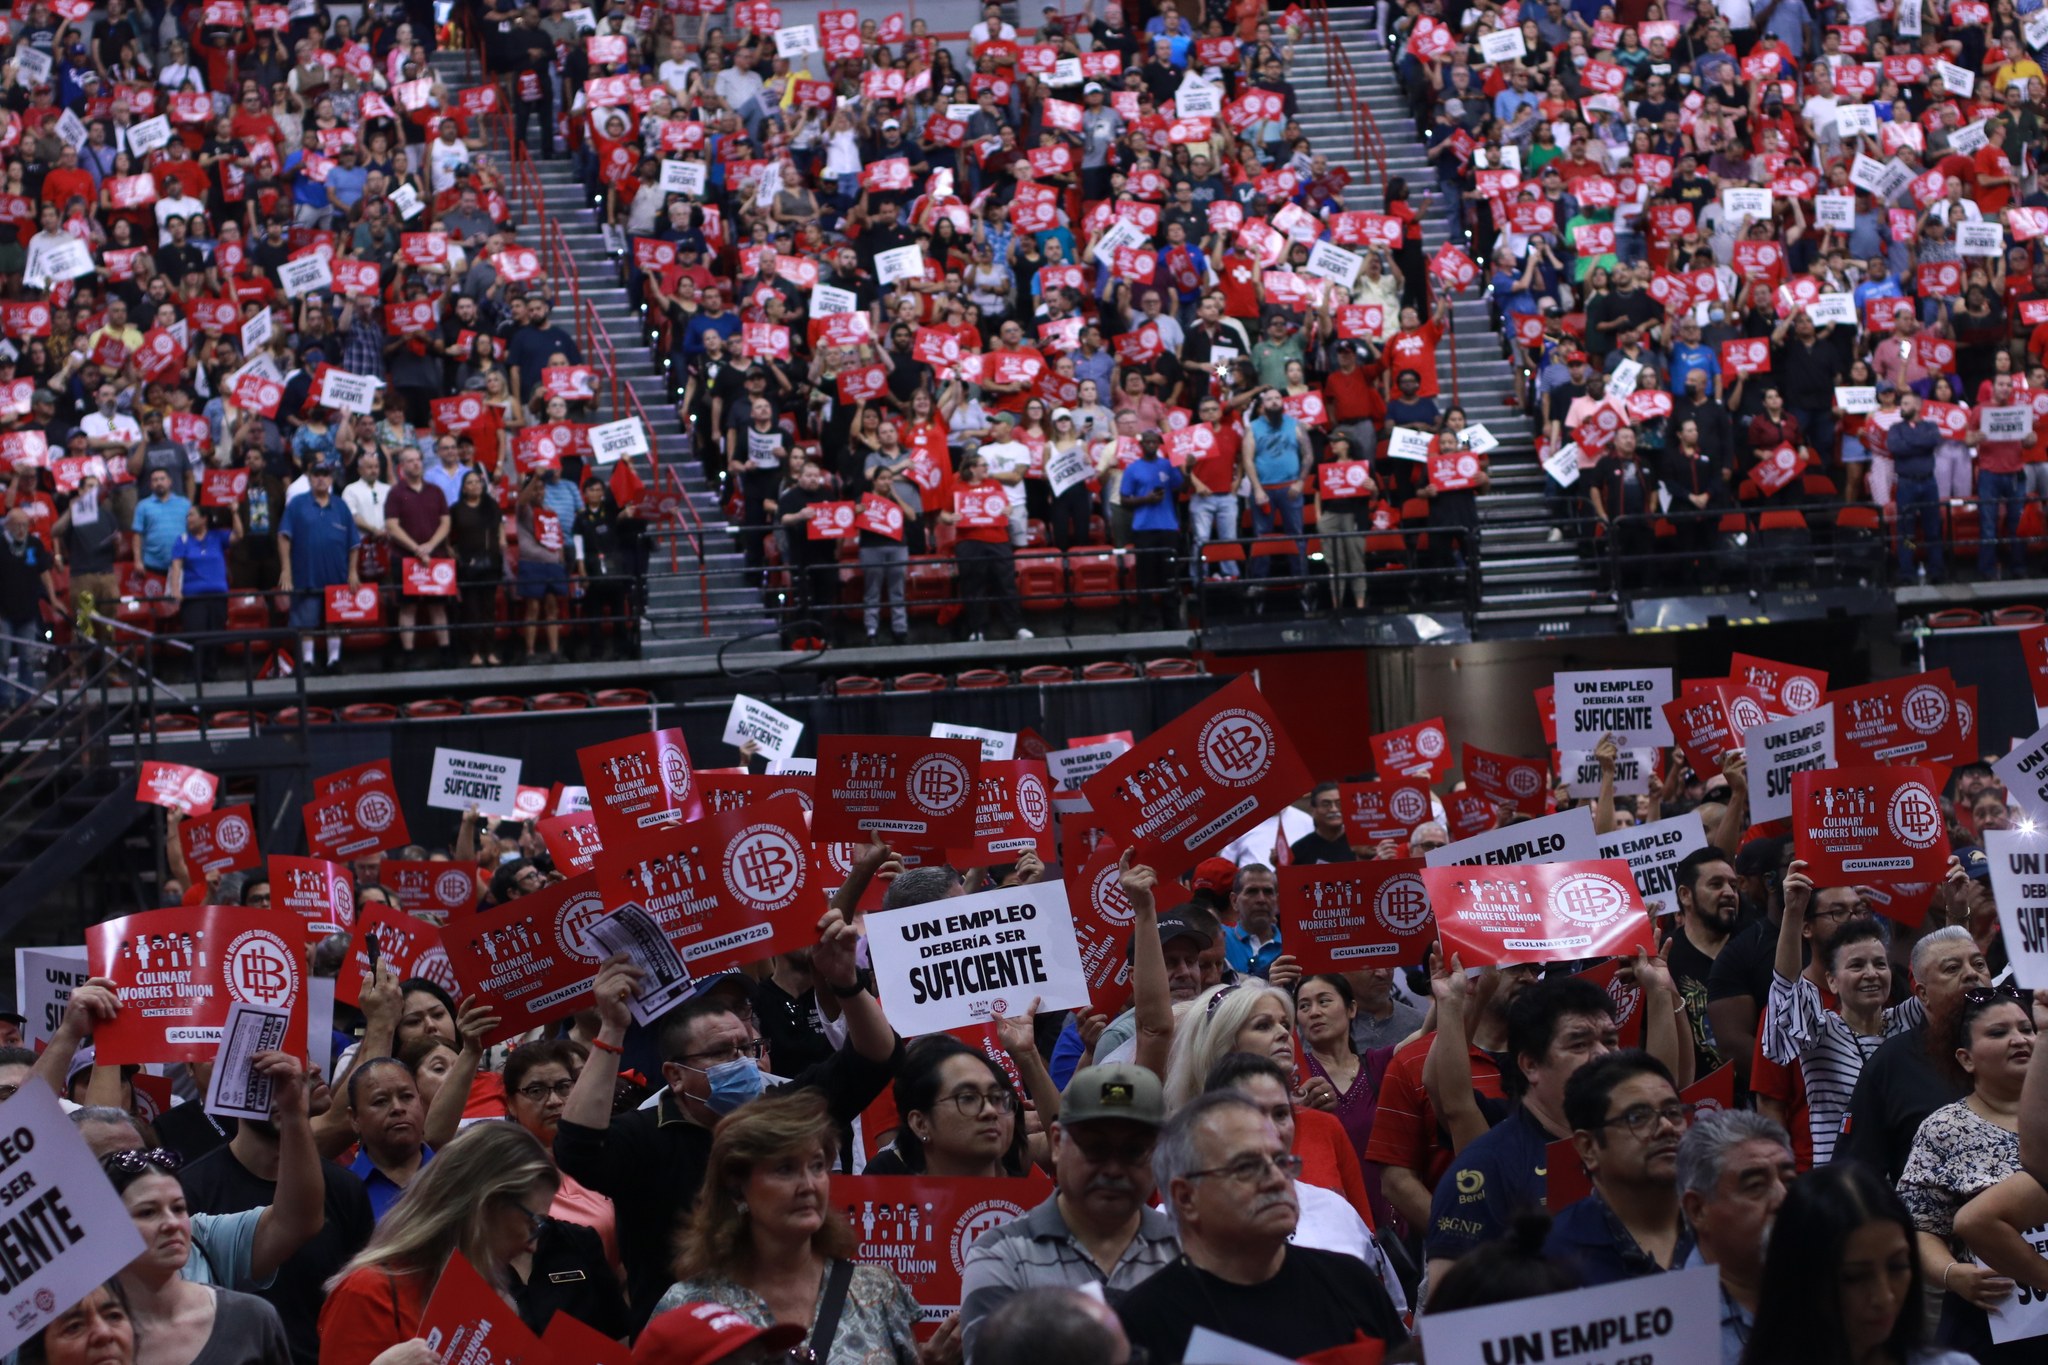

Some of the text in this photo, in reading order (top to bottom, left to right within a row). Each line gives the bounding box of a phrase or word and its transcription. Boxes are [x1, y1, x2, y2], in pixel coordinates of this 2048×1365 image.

[1574, 680, 1653, 693] UN EMPLEO
[1627, 695, 1645, 703] SER
[1211, 708, 1246, 723] DISPENSERS
[1246, 709, 1263, 723] UNION
[1574, 706, 1652, 732] SUFICIENTE
[1855, 718, 1885, 730] CULINARY
[736, 721, 783, 751] SUFICIENTE
[1199, 722, 1212, 752] BEVERAGE
[1261, 722, 1274, 741] LOCAL
[1764, 720, 1826, 749] UN EMPLEO
[1846, 723, 1898, 740] WORKERS UNION
[466, 761, 506, 774] EMPLEO
[1060, 751, 1112, 767] UN EMPLEO
[2017, 747, 2045, 773] UN
[1200, 758, 1230, 788] BARTENDERS
[443, 776, 502, 801] SUFICIENTE
[614, 777, 646, 793] CULINARY
[846, 779, 883, 789] CULINARY
[605, 789, 638, 806] WORKERS
[638, 784, 660, 796] UNION
[832, 789, 897, 799] WORKERS UNION
[1141, 785, 1185, 818] CULINARY
[993, 811, 1015, 821] UNION
[1132, 786, 1206, 839] WORKERS UNION
[747, 823, 786, 837] DISPENSERS
[860, 821, 924, 831] @CULINARY226
[1188, 800, 1255, 848] @CULINARY226
[1823, 816, 1864, 828] CULINARY
[785, 830, 801, 850] UNION
[1808, 826, 1879, 839] WORKERS UNION
[725, 832, 747, 866] BEVERAGE
[1484, 833, 1566, 866] EMPLEO
[1622, 830, 1682, 854] EMPLEO
[797, 848, 807, 871] LOCAL
[1655, 849, 1676, 862] SER
[1845, 859, 1911, 869] @CULINARY226
[2009, 853, 2041, 875] UN
[723, 871, 748, 906] BARTENDERS
[644, 888, 695, 914] CULINARY
[684, 895, 719, 917] UNION
[1472, 902, 1521, 912] CULINARY
[1313, 908, 1351, 920] CULINARY
[1457, 910, 1542, 921] WORKERS UNION
[901, 904, 1037, 942] UN EMPLEO
[1299, 916, 1366, 931] WORKERS UNION
[686, 927, 770, 959] @CULINARY226
[995, 929, 1027, 944] SER
[1507, 937, 1588, 948] @CULINARY226
[1094, 934, 1115, 960] UNION
[1333, 945, 1397, 957] @CULINARY226
[490, 951, 534, 975] CULINARY
[46, 968, 71, 986] UN
[136, 970, 191, 985] CULINARY
[479, 955, 555, 993] WORKERS UNION
[909, 945, 1048, 1005] SUFICIENTE
[116, 984, 214, 1001] WORKERS UNION
[529, 977, 597, 1010] @CULINARY22
[169, 1031, 222, 1040] @CULINA
[1459, 1189, 1486, 1204] Berel
[960, 1201, 989, 1228] BEVERAGE
[1449, 1217, 1483, 1234] GNP
[858, 1242, 916, 1258] CULINARY
[897, 1258, 937, 1273] UNION
[1481, 1307, 1673, 1365] UN EMPLEO
